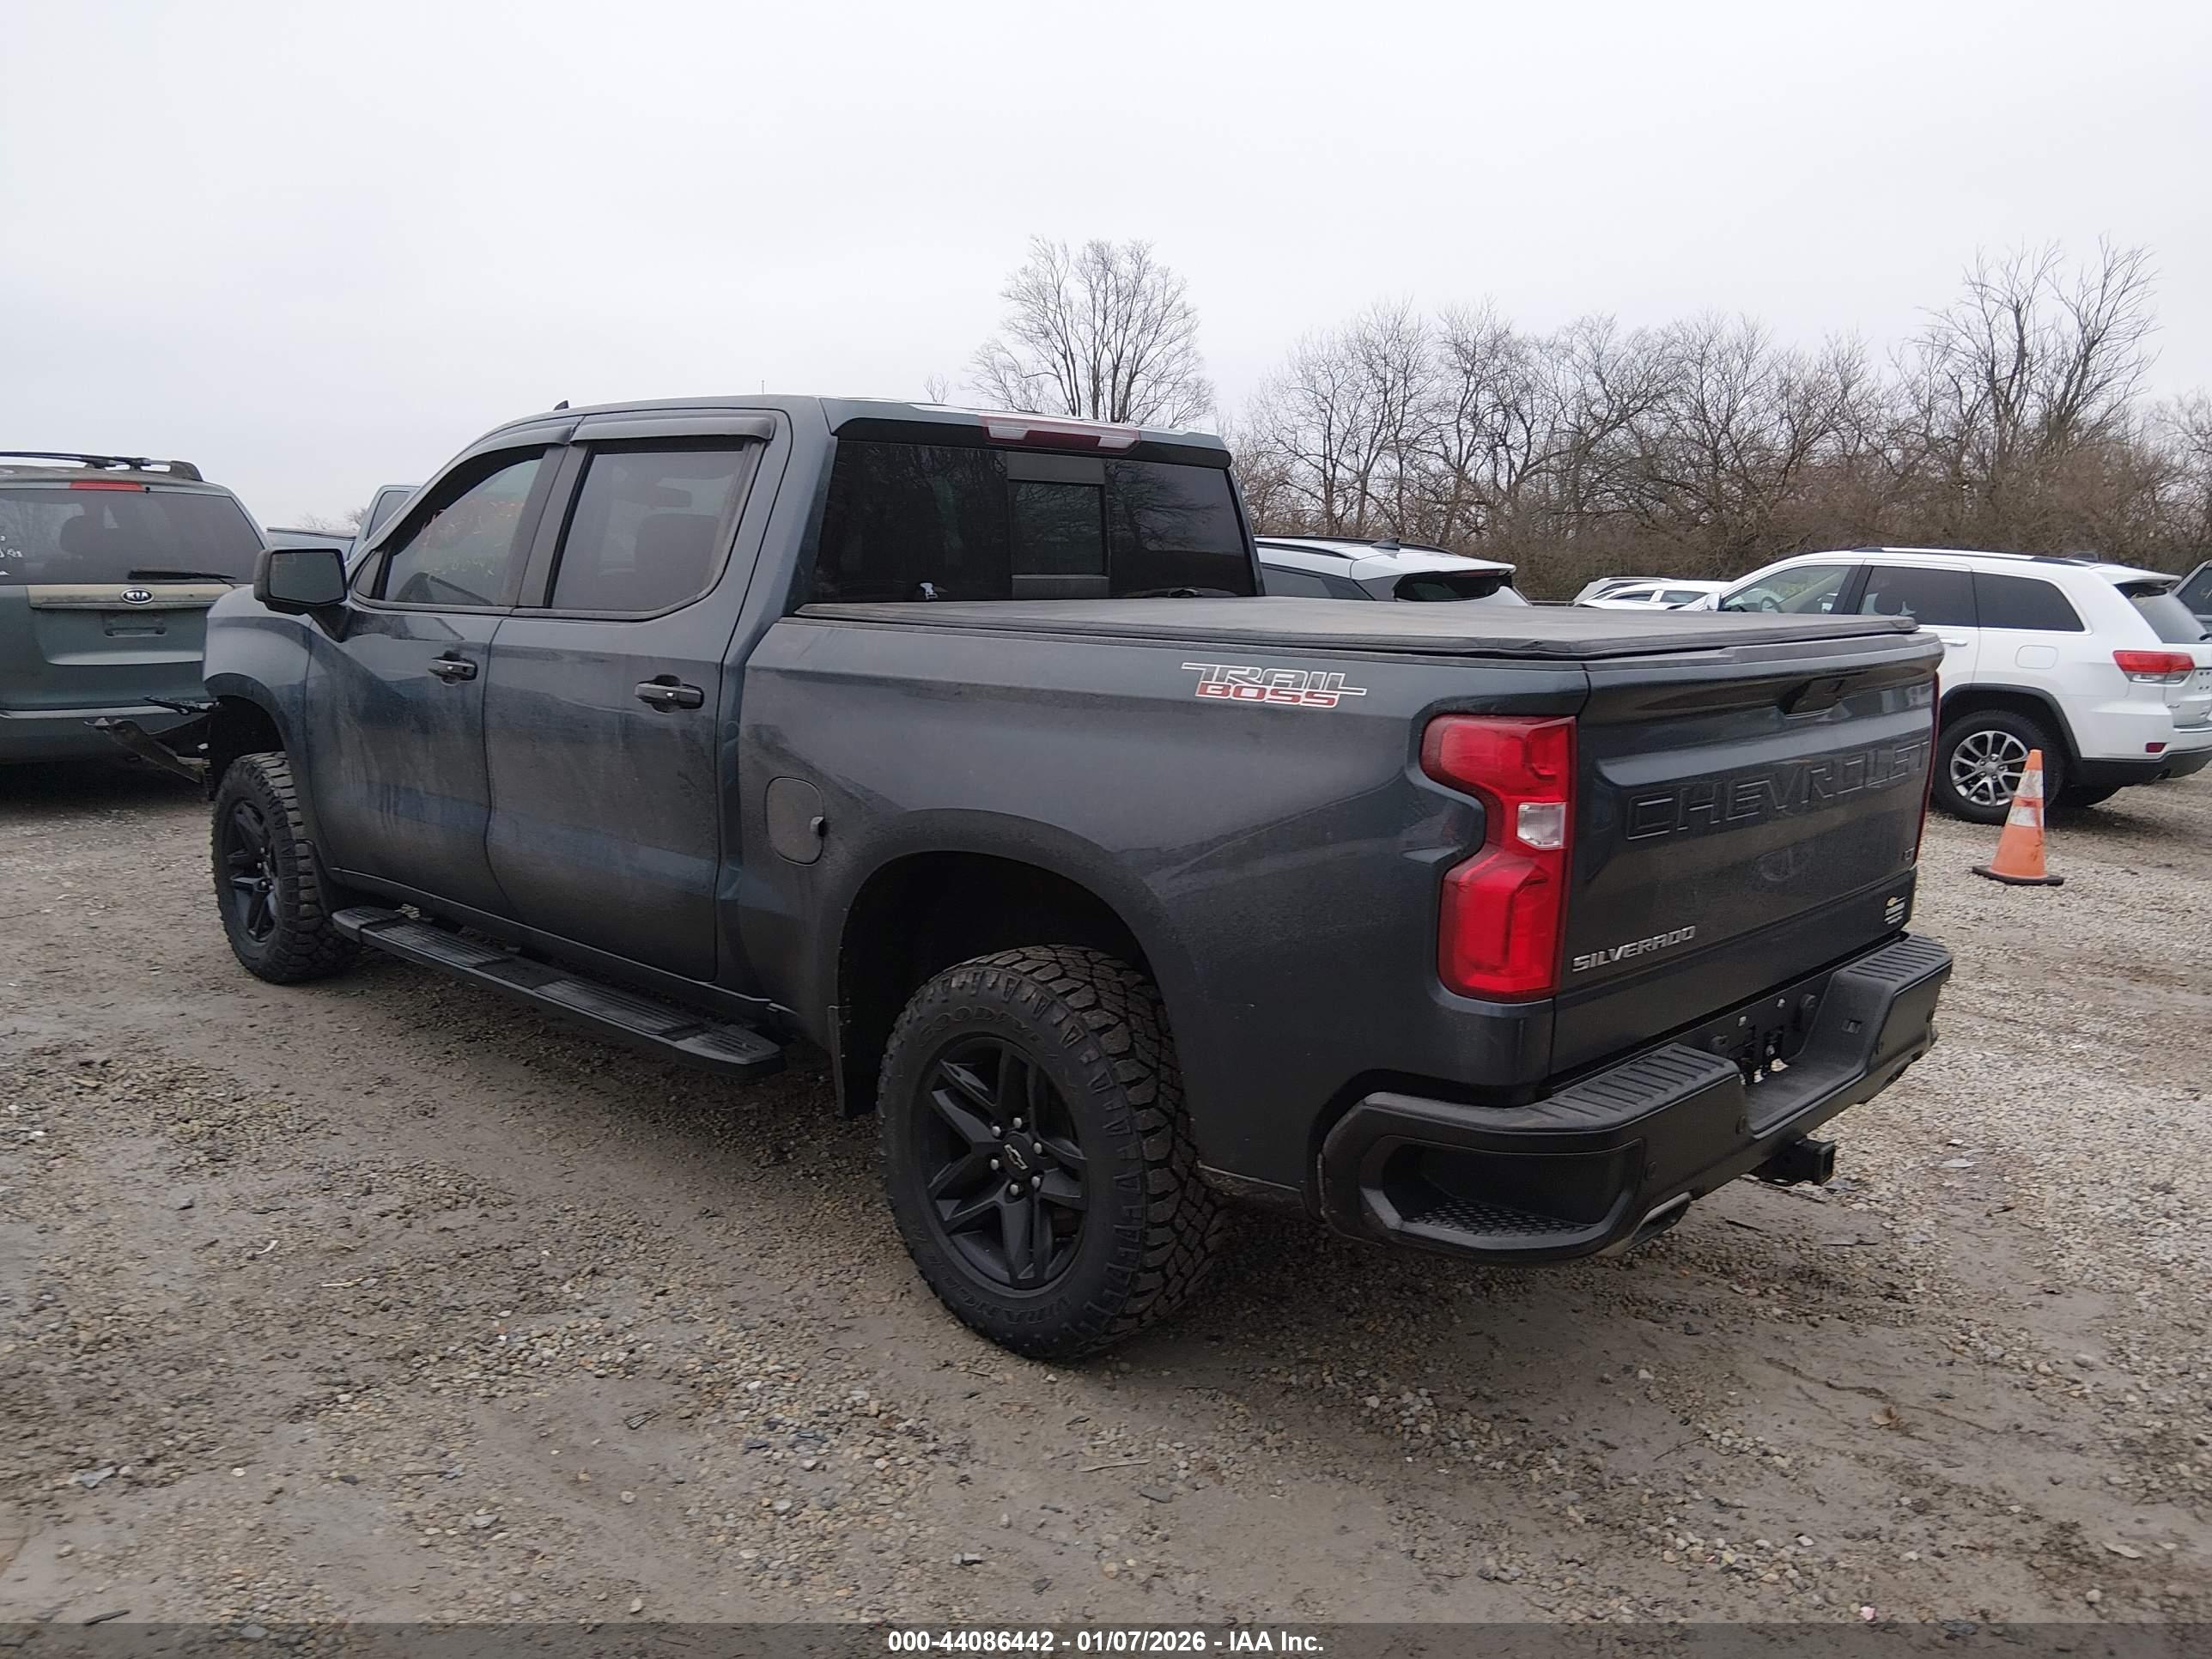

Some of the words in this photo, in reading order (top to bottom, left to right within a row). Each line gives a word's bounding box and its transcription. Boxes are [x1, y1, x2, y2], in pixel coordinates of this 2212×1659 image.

[126, 591, 149, 601] KIA
[1182, 662, 1368, 696] TRAIL
[1194, 681, 1340, 708] BOSS
[1626, 739, 1930, 842] CHEVROLET
[1571, 925, 1697, 973] SILVERADO
